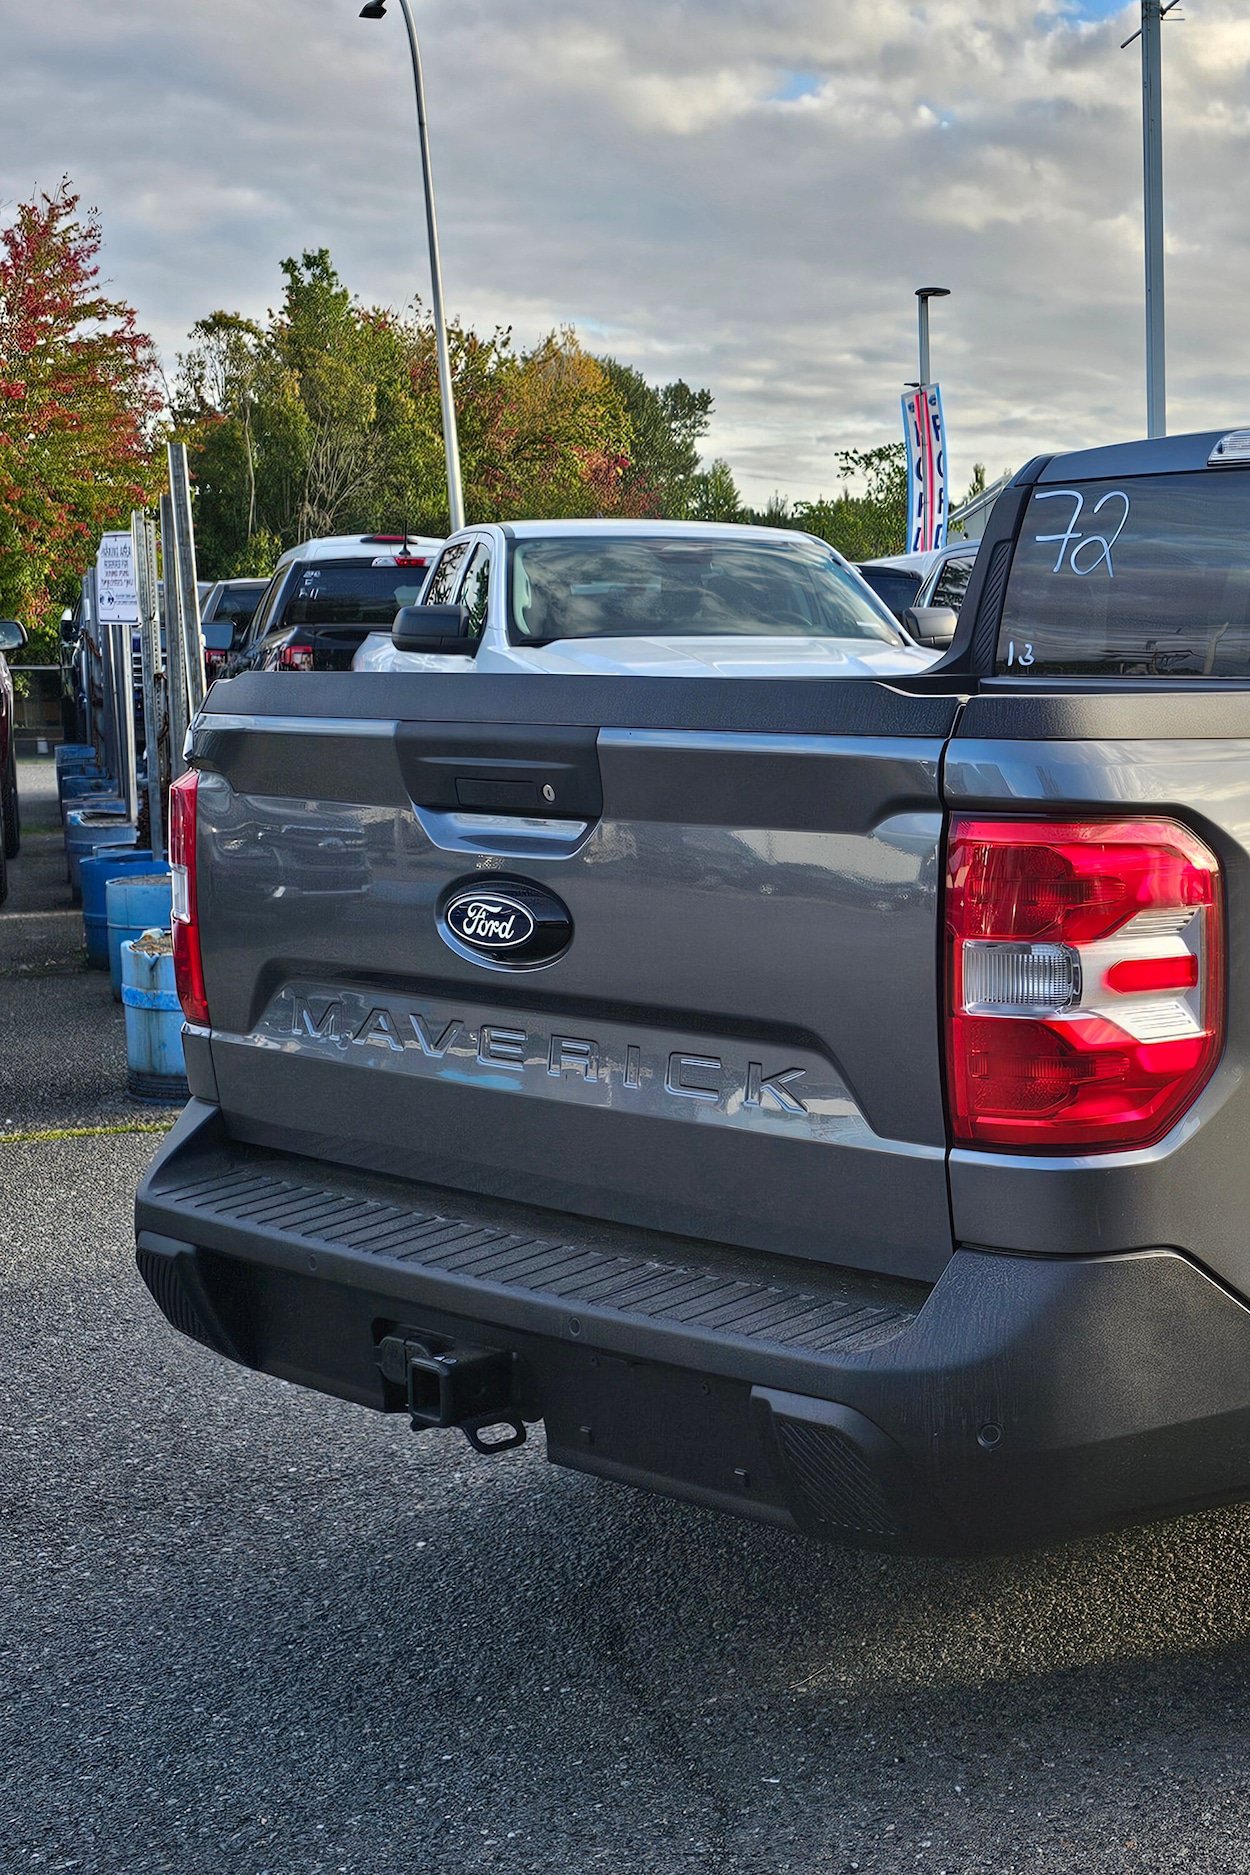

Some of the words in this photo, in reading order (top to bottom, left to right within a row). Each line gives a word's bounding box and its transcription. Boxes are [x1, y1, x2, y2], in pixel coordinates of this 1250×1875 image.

[1034, 489, 1131, 578] 72
[1007, 640, 1036, 667] 13
[462, 902, 517, 940] Ford
[290, 996, 809, 1114] MAVERICK
